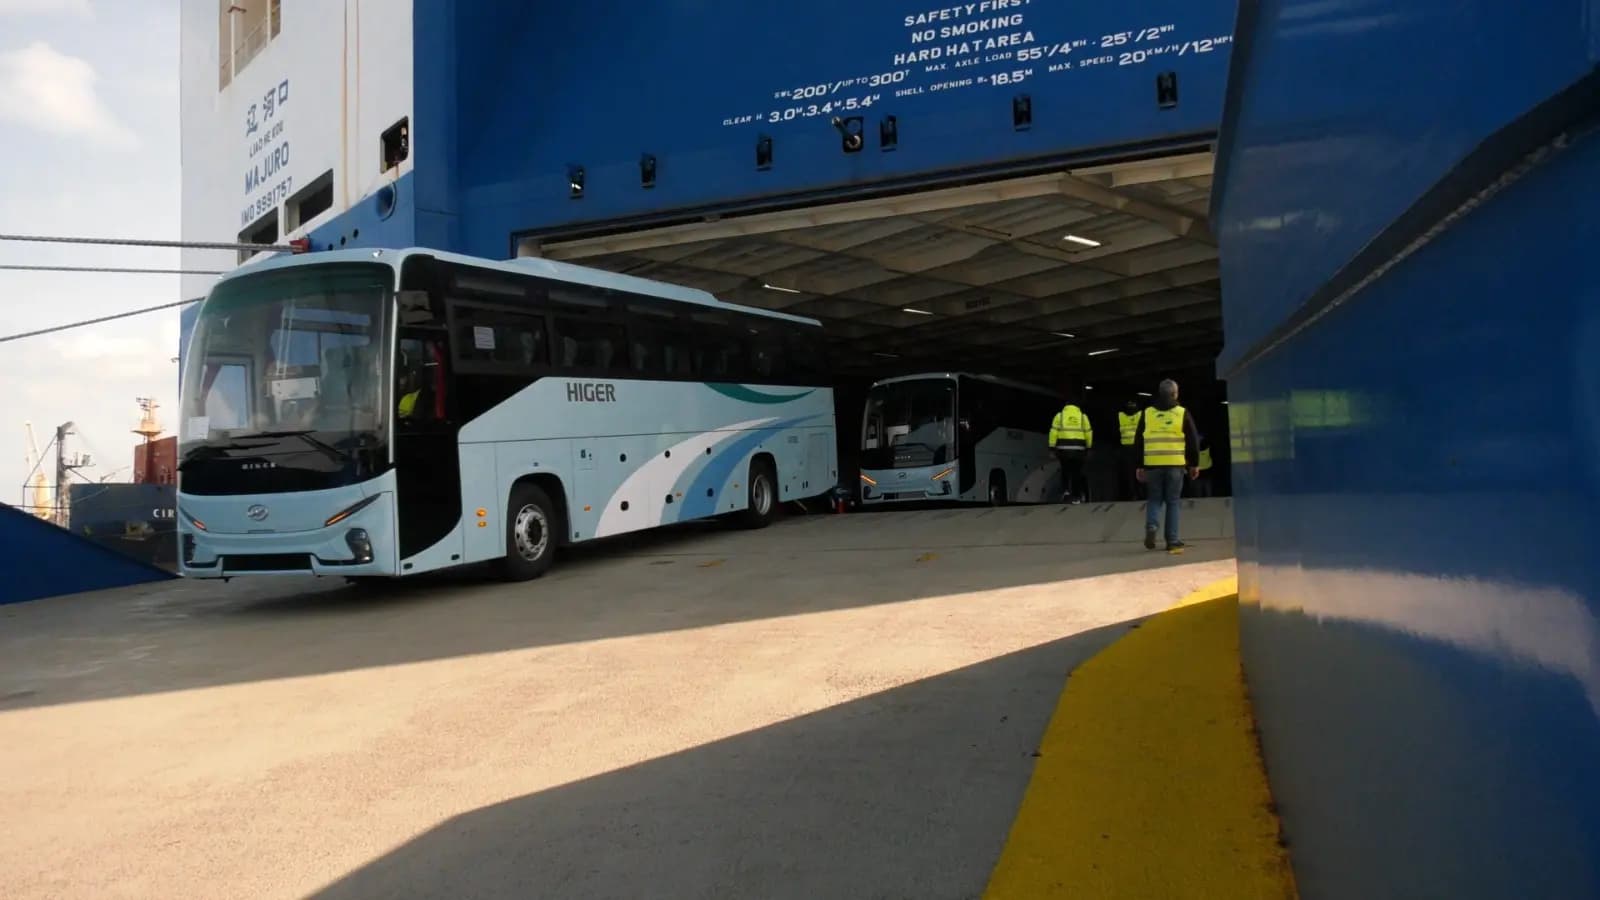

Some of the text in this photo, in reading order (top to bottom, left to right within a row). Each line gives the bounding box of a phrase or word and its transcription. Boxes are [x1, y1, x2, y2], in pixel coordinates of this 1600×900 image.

[904, 4, 976, 27] SAFETY
[911, 13, 1024, 44] NO SMOKING
[894, 47, 942, 66] HARD
[955, 57, 980, 68] AXLE
[985, 52, 1011, 63] LOAD
[723, 115, 752, 125] CLEAR
[895, 86, 924, 97] SHELL
[930, 78, 972, 91] OPENING
[1080, 56, 1113, 67] SPEED
[249, 137, 263, 158] LIAO
[245, 141, 289, 195] MAJURO
[241, 204, 255, 225] IMO
[566, 382, 616, 402] HIGER
